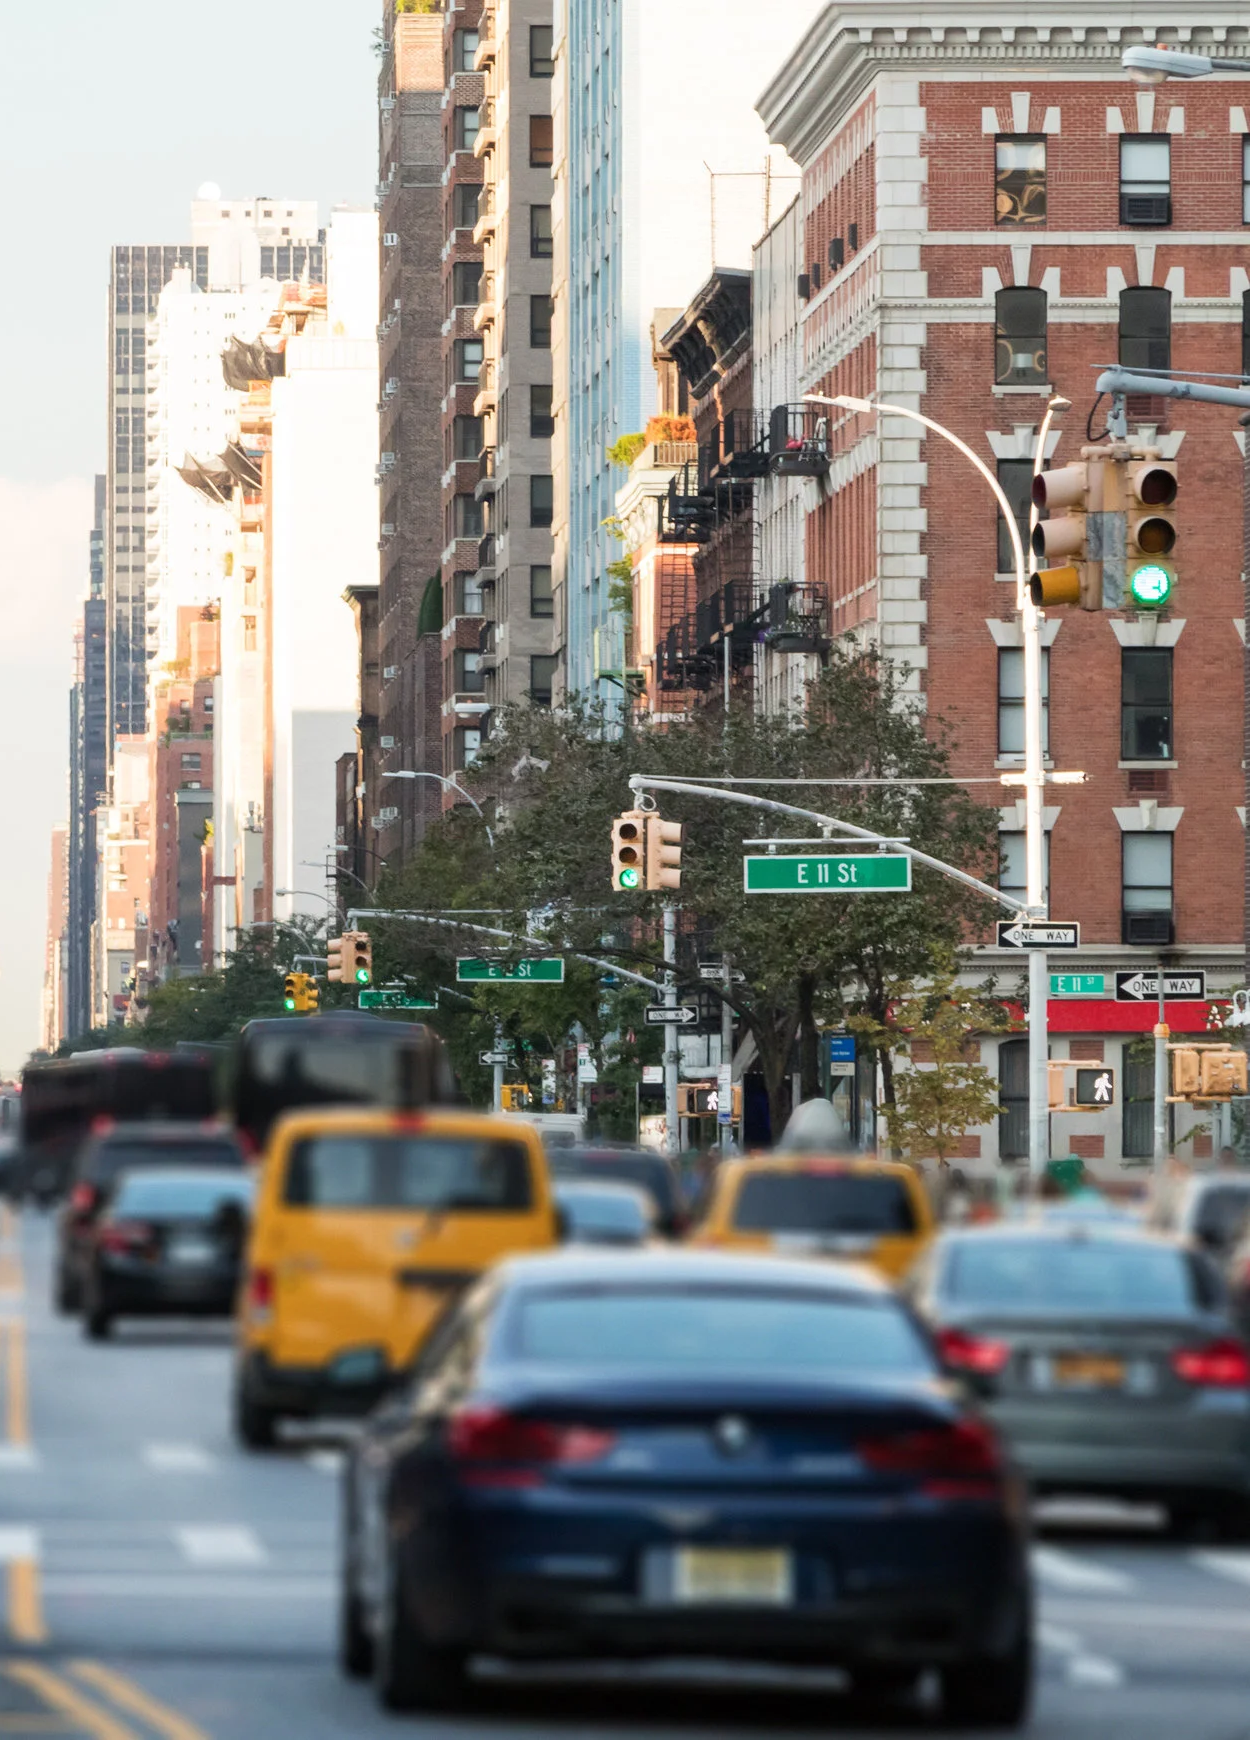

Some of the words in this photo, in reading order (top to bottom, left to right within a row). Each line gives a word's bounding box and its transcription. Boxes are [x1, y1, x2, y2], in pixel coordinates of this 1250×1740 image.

[797, 863, 809, 883] E
[817, 863, 829, 883] 11
[838, 862, 857, 883] St
[1013, 930, 1035, 941] ONE
[1046, 931, 1069, 941] WAY
[518, 963, 532, 977] St
[1057, 976, 1066, 992] E
[1072, 976, 1081, 992] 11
[1086, 976, 1095, 985] ST
[1132, 981, 1157, 992] ONE
[1168, 981, 1195, 992] WAY
